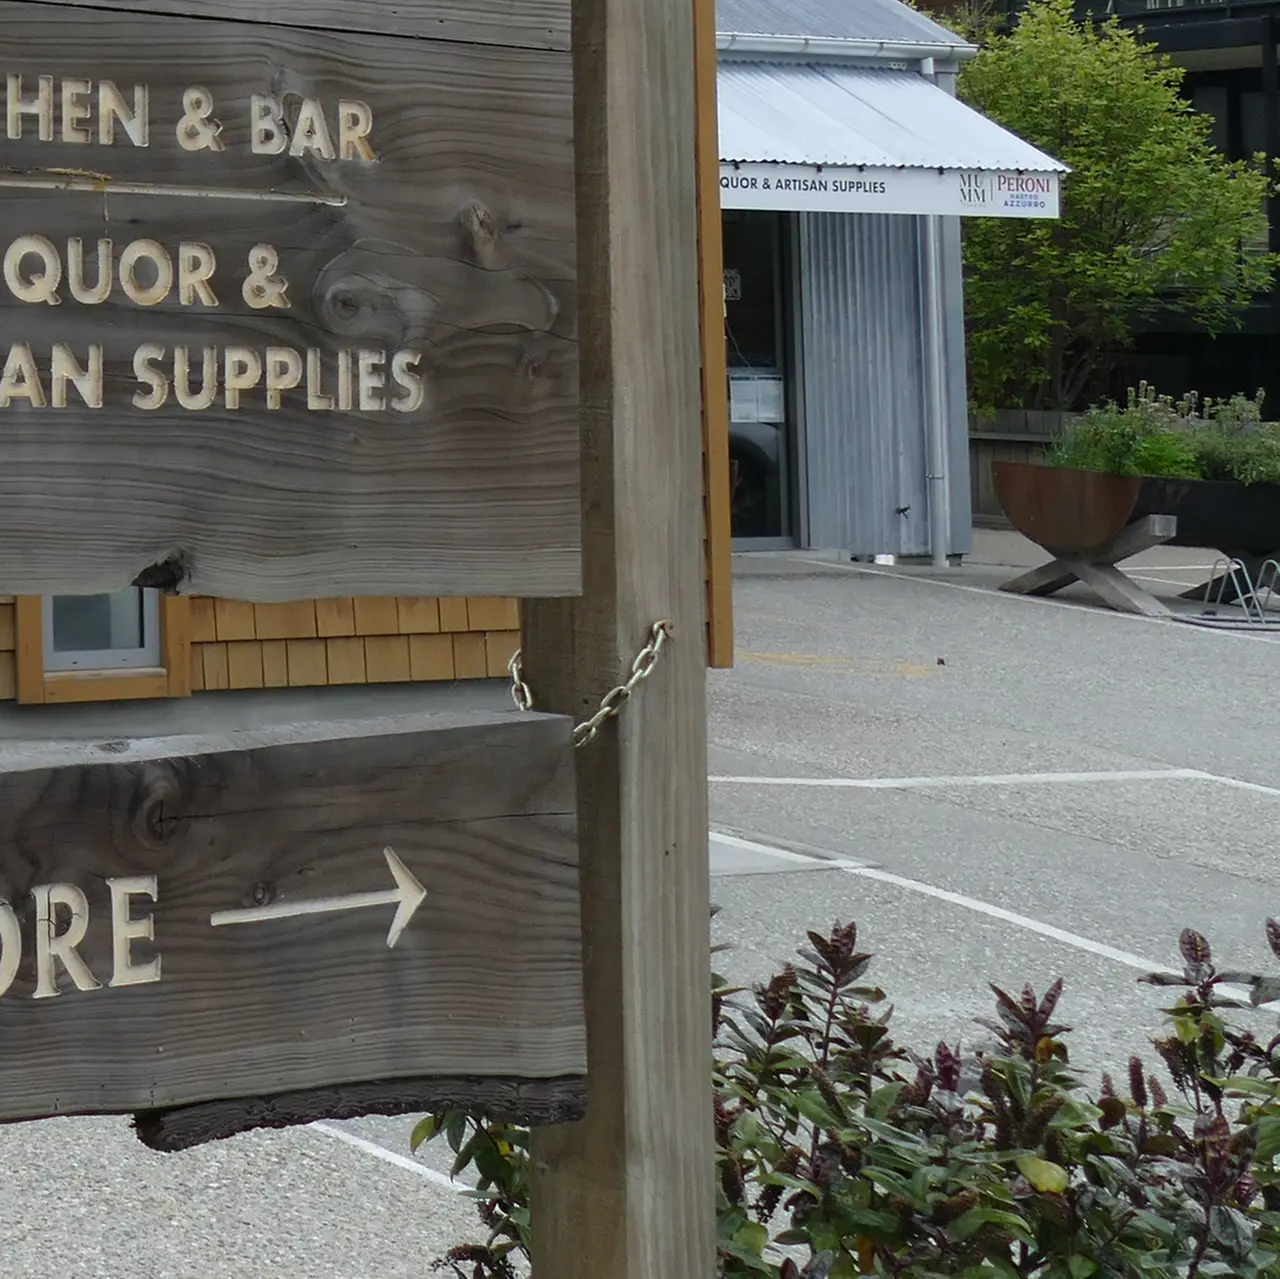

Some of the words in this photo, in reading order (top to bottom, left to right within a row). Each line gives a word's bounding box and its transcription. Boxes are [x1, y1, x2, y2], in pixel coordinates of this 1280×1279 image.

[176, 85, 226, 152] &
[251, 91, 380, 163] BAR
[762, 177, 771, 190] &
[775, 178, 828, 192] ARTISAN
[832, 180, 886, 194] SUPPLIES
[997, 175, 1050, 193] PERONI
[1003, 200, 1046, 208] AZZURRO
[241, 242, 292, 310] &
[131, 340, 426, 415] SUPPLIES
